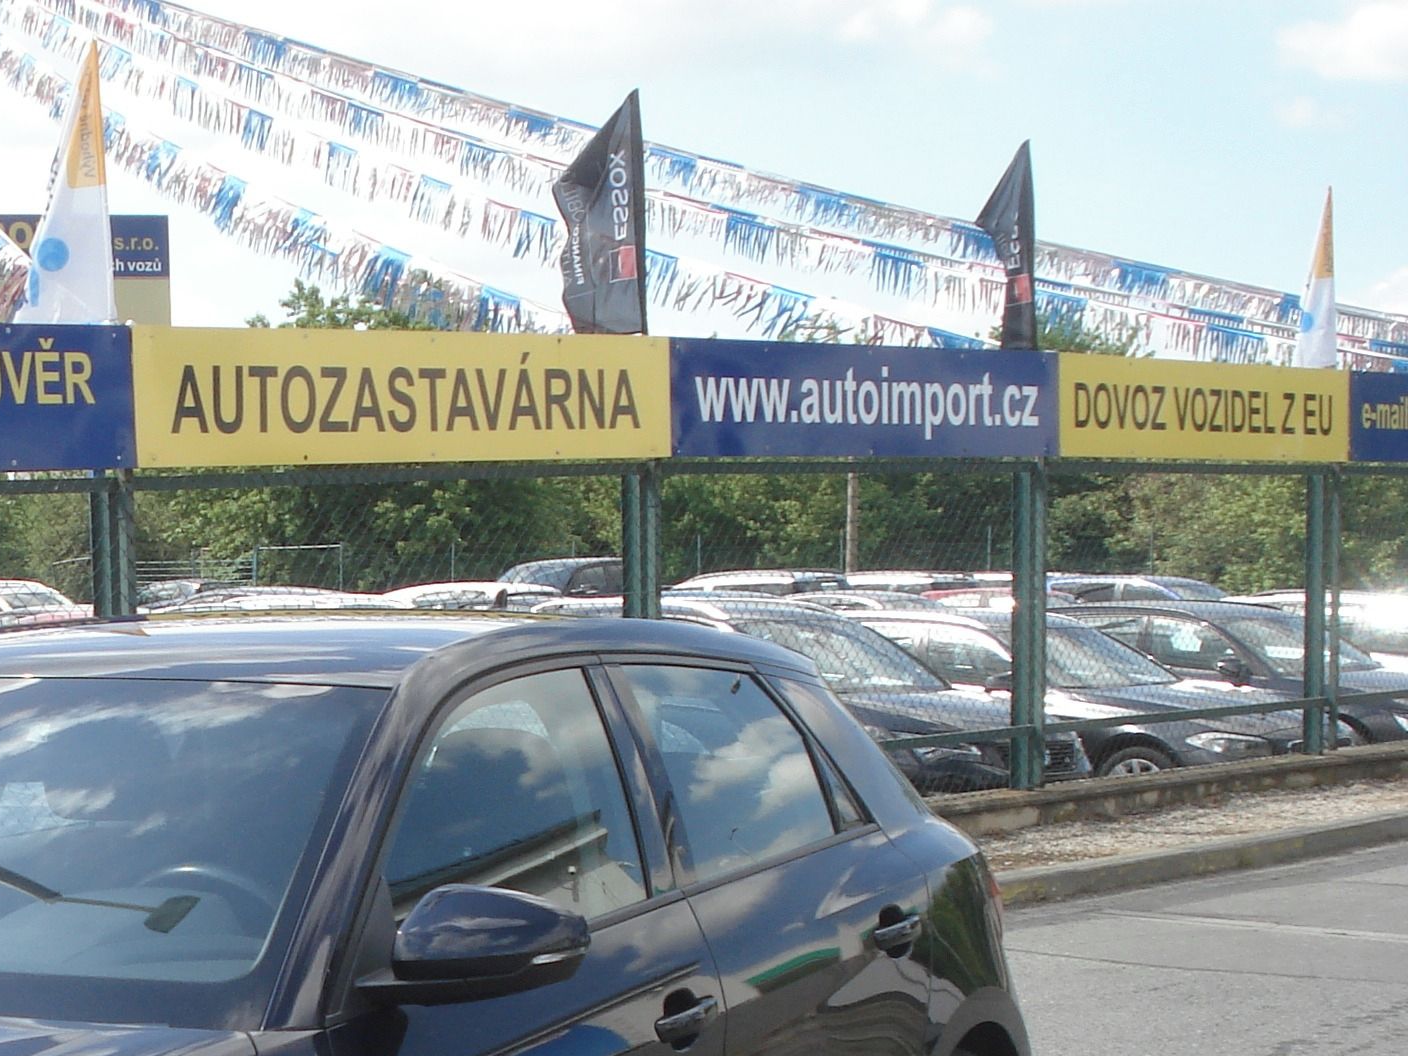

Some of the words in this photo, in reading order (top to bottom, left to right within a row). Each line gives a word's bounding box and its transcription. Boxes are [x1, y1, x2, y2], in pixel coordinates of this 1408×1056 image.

[114, 236, 159, 250] s.r.o.
[127, 257, 163, 272] vozů
[171, 351, 641, 434] AUTOZASTAVÁRNA
[695, 367, 1040, 440] www.autoimport.cz
[1073, 381, 1165, 430] DOVOZ
[1174, 385, 1274, 433] VOZIDEL
[1280, 391, 1296, 435] Z
[1303, 392, 1334, 436] EU
